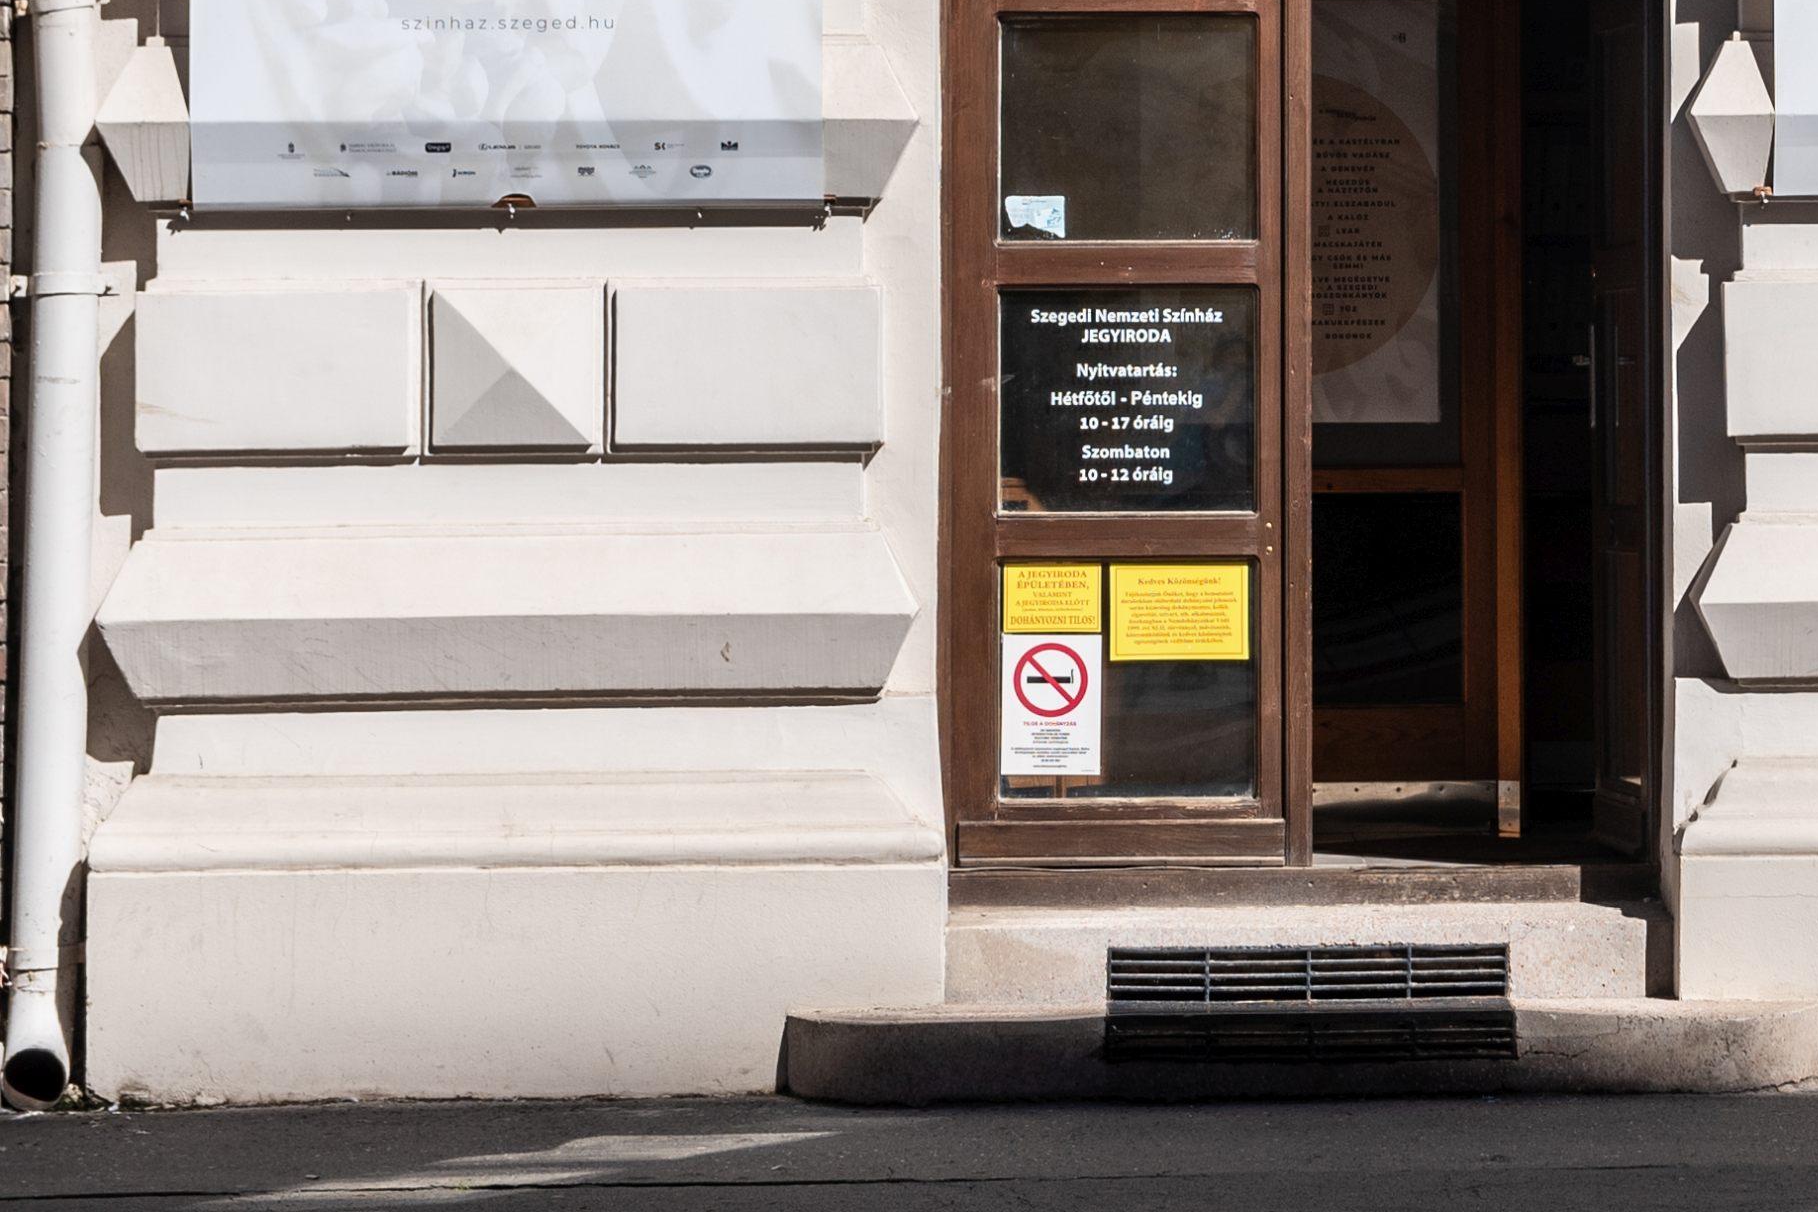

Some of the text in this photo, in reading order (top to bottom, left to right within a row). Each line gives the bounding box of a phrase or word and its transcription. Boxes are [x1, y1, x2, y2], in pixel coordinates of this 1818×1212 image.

[402, 16, 616, 32] szinhaz.szeged.hu
[1031, 308, 1222, 326] Szegedi Nemzeti Színház
[1081, 329, 1171, 343] JEGYIRODA
[1077, 363, 1177, 380] Nyitvatartás:
[1131, 391, 1202, 408] Péntekig
[1080, 417, 1098, 429] 10
[1112, 417, 1130, 429] 17
[1133, 416, 1174, 432] óráig
[1082, 445, 1170, 458] Szombaton
[1079, 469, 1098, 481] 10
[1111, 469, 1129, 481] 12
[1133, 467, 1173, 484] óráig
[1017, 580, 1089, 589] ÉPÜLETÉBEN,
[1011, 615, 1095, 625] DOHÁNYOZNI TILOS!
